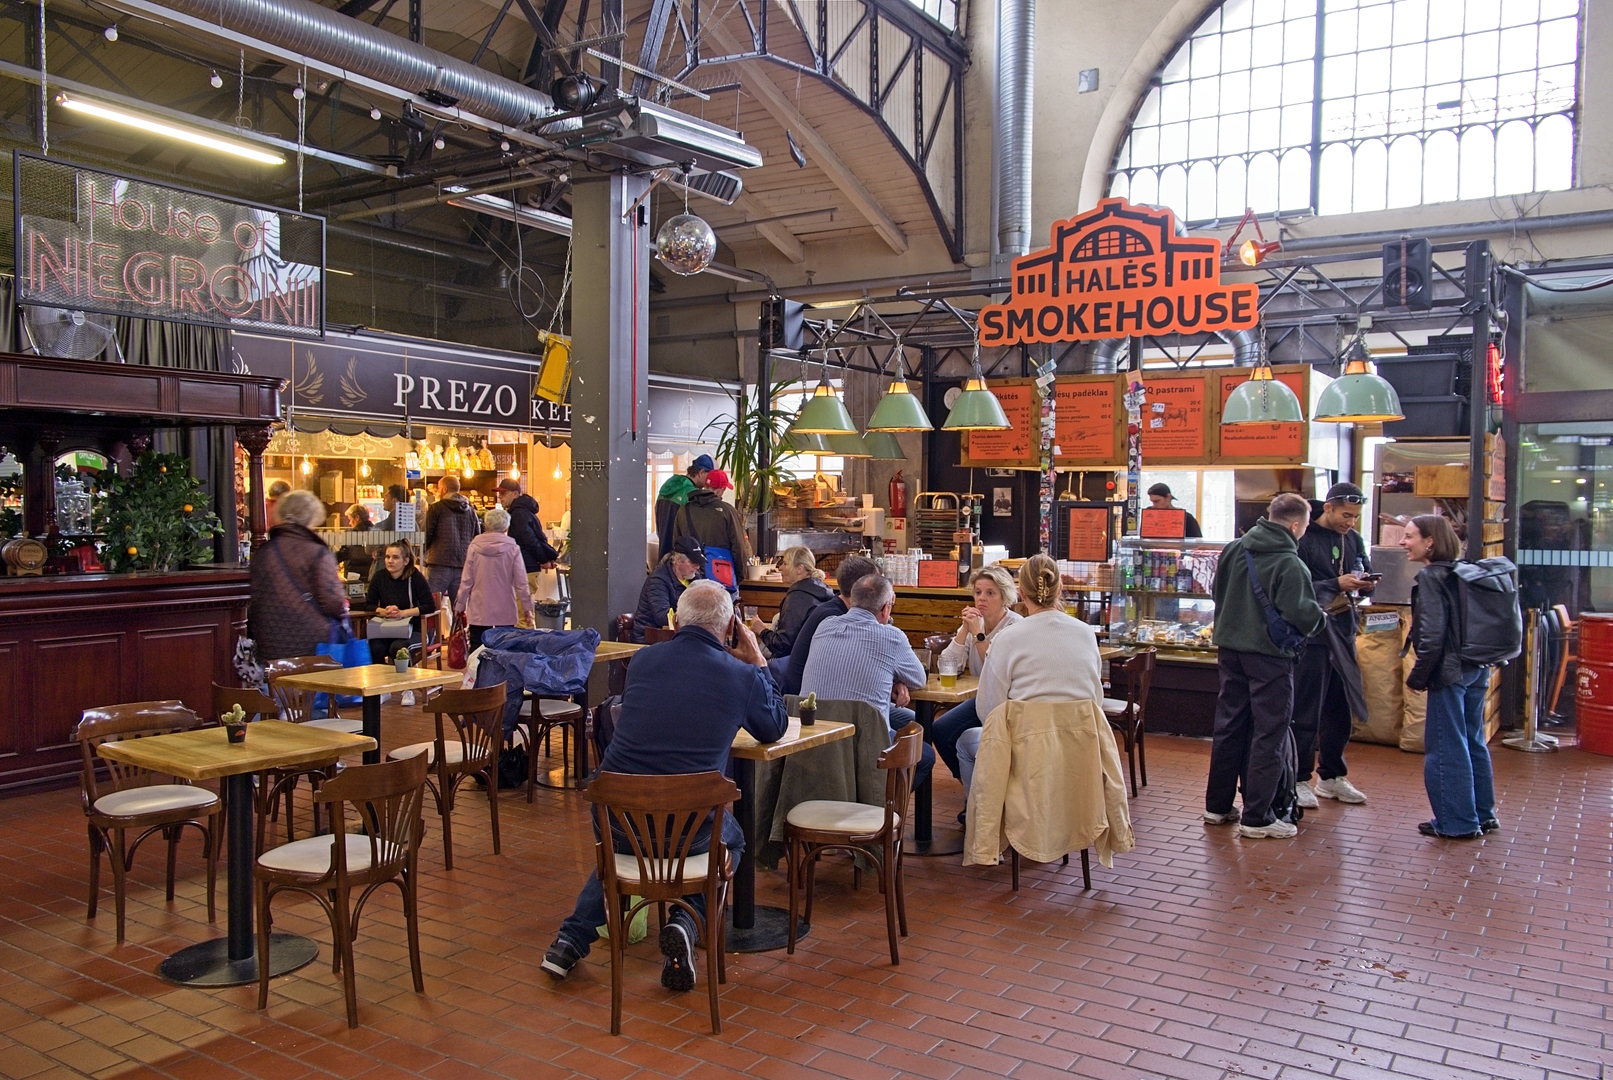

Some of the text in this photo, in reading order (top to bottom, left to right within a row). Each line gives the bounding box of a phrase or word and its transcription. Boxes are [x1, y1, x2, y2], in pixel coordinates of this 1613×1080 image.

[91, 183, 270, 254] House of
[30, 232, 316, 327] NEGRONI
[1066, 259, 1158, 293] HALĖS
[983, 290, 1253, 340] SMOKEHOUSE
[393, 372, 517, 417] PREZO
[996, 392, 1018, 401] ėkštės
[1055, 389, 1108, 399] ėsų padėklas
[1156, 385, 1195, 396] pastrami
